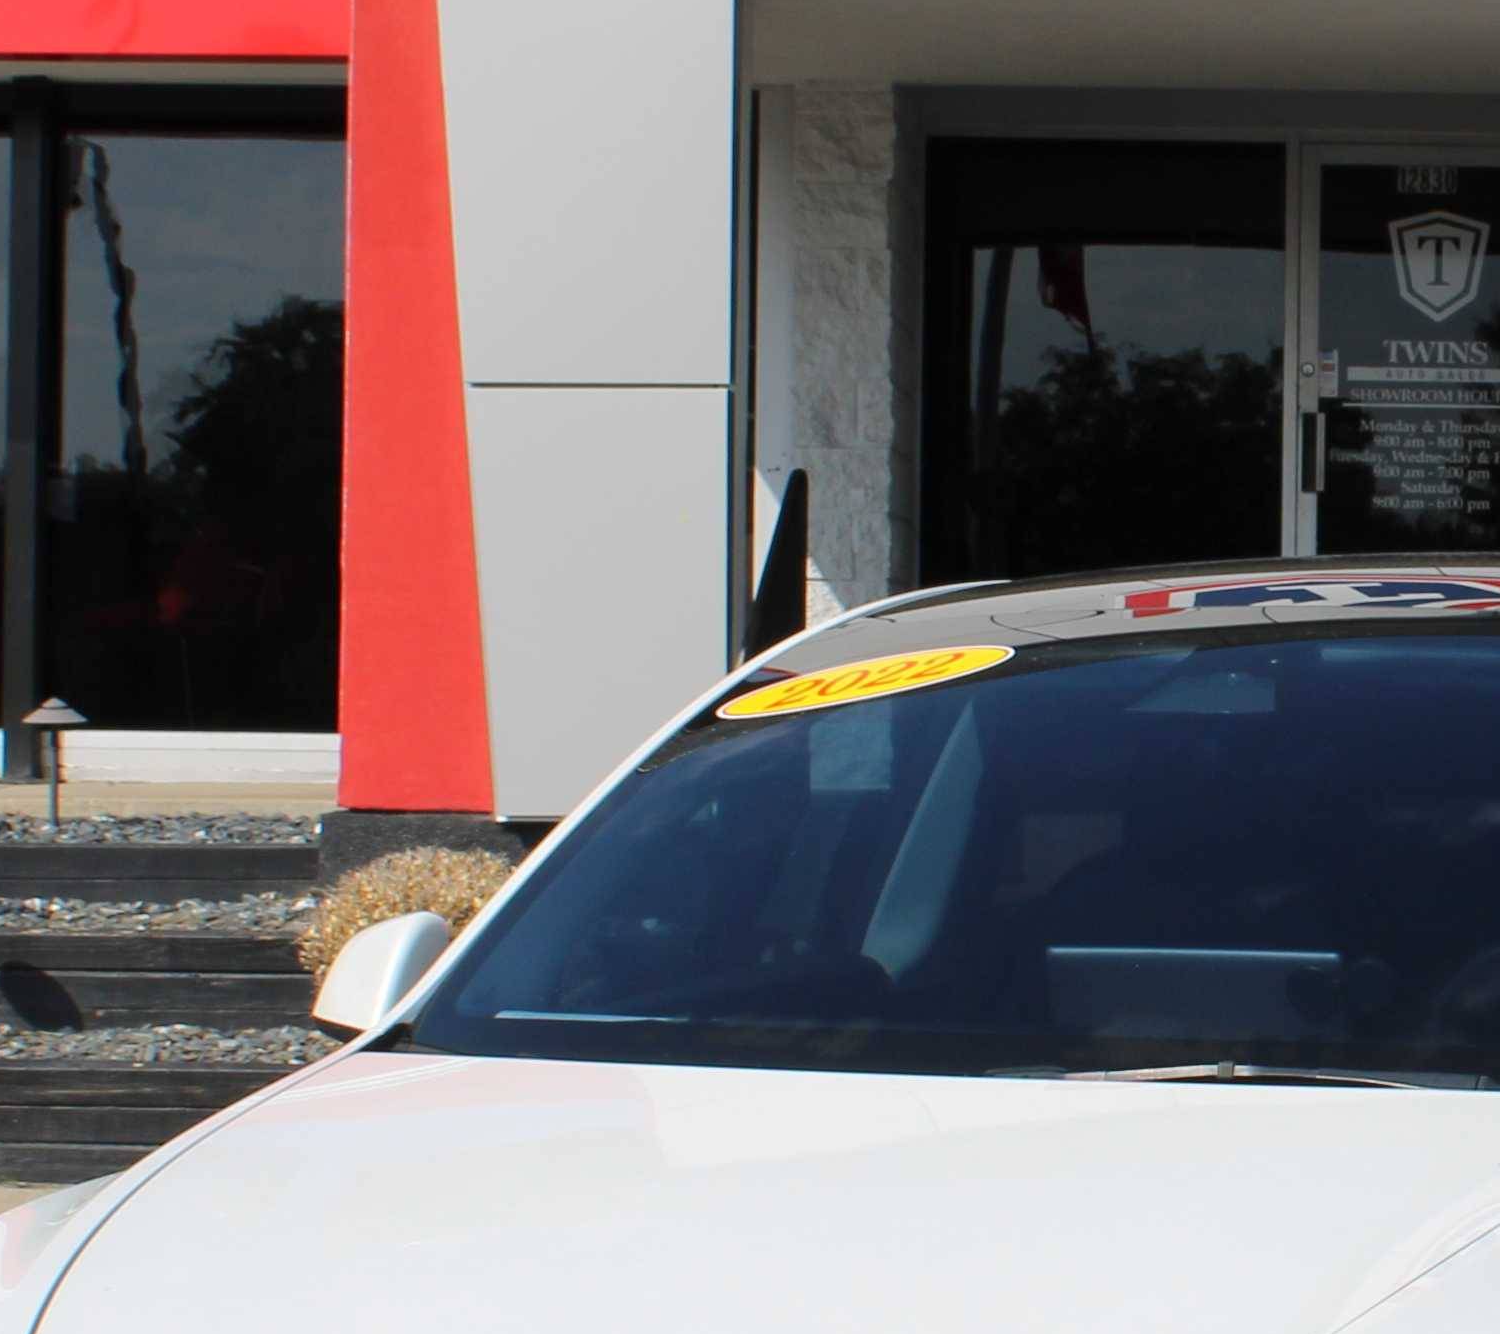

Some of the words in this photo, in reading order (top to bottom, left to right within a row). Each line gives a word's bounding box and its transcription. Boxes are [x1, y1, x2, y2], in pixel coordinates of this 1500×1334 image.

[1417, 235, 1461, 286] T
[1382, 339, 1489, 364] TWINS
[1385, 369, 1426, 380] AUTO
[1436, 370, 1487, 381] SALES
[1350, 388, 1454, 403] SHOWROOM
[1359, 419, 1417, 437] Monday
[1422, 420, 1435, 434] &
[1373, 436, 1400, 448] 9:00
[1403, 438, 1425, 448] am
[1437, 436, 1464, 449] 8:00
[1467, 439, 1492, 451] pm
[1391, 450, 1472, 466] Wednesday
[1476, 452, 1491, 465] &
[1373, 466, 1400, 479] 9:00
[1403, 468, 1425, 479] am
[1437, 466, 1464, 480] 7:00
[1467, 469, 1491, 484] pm
[1399, 481, 1461, 496] Saturday
[1372, 496, 1399, 509] 9:00
[1403, 498, 1425, 509] am
[1467, 499, 1491, 514] pm
[764, 651, 966, 710] 2022
